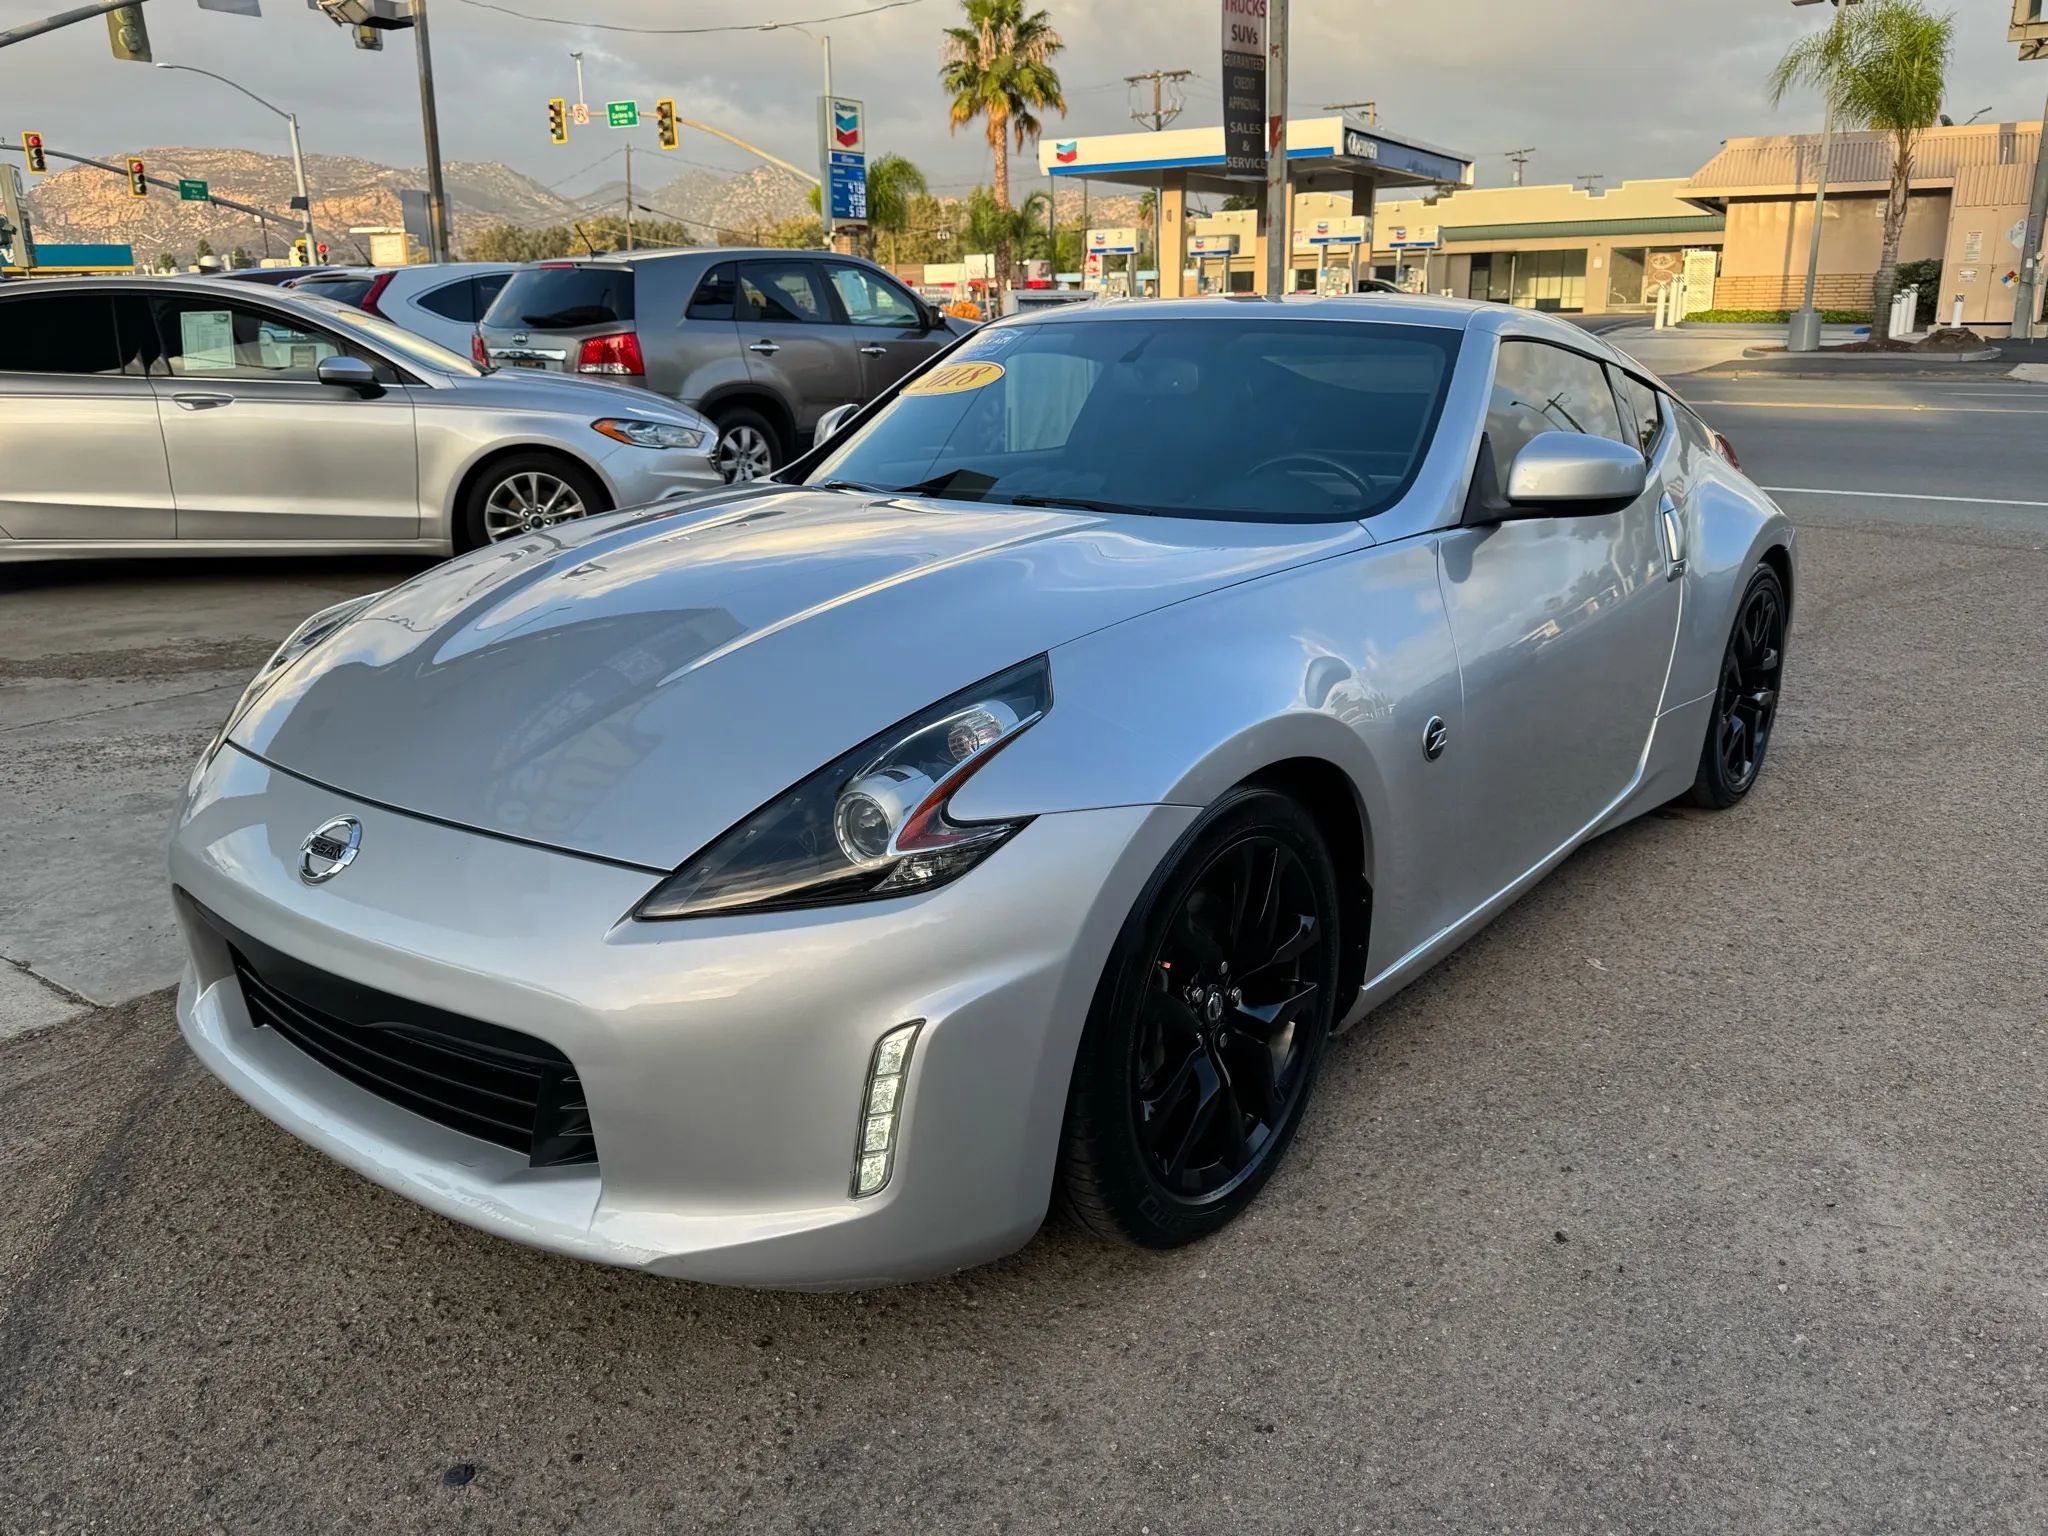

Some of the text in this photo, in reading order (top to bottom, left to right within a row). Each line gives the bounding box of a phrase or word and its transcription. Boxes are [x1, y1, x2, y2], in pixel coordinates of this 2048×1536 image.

[1224, 0, 1266, 17] TRUCKS
[1231, 23, 1258, 45] SUVs
[1223, 52, 1265, 71] GUARANTEED
[1232, 76, 1256, 90] CREDIT
[1228, 96, 1261, 112] APPROVAL
[1230, 121, 1262, 135] SALES
[1241, 140, 1250, 151] &
[1227, 156, 1266, 169] SERVICE
